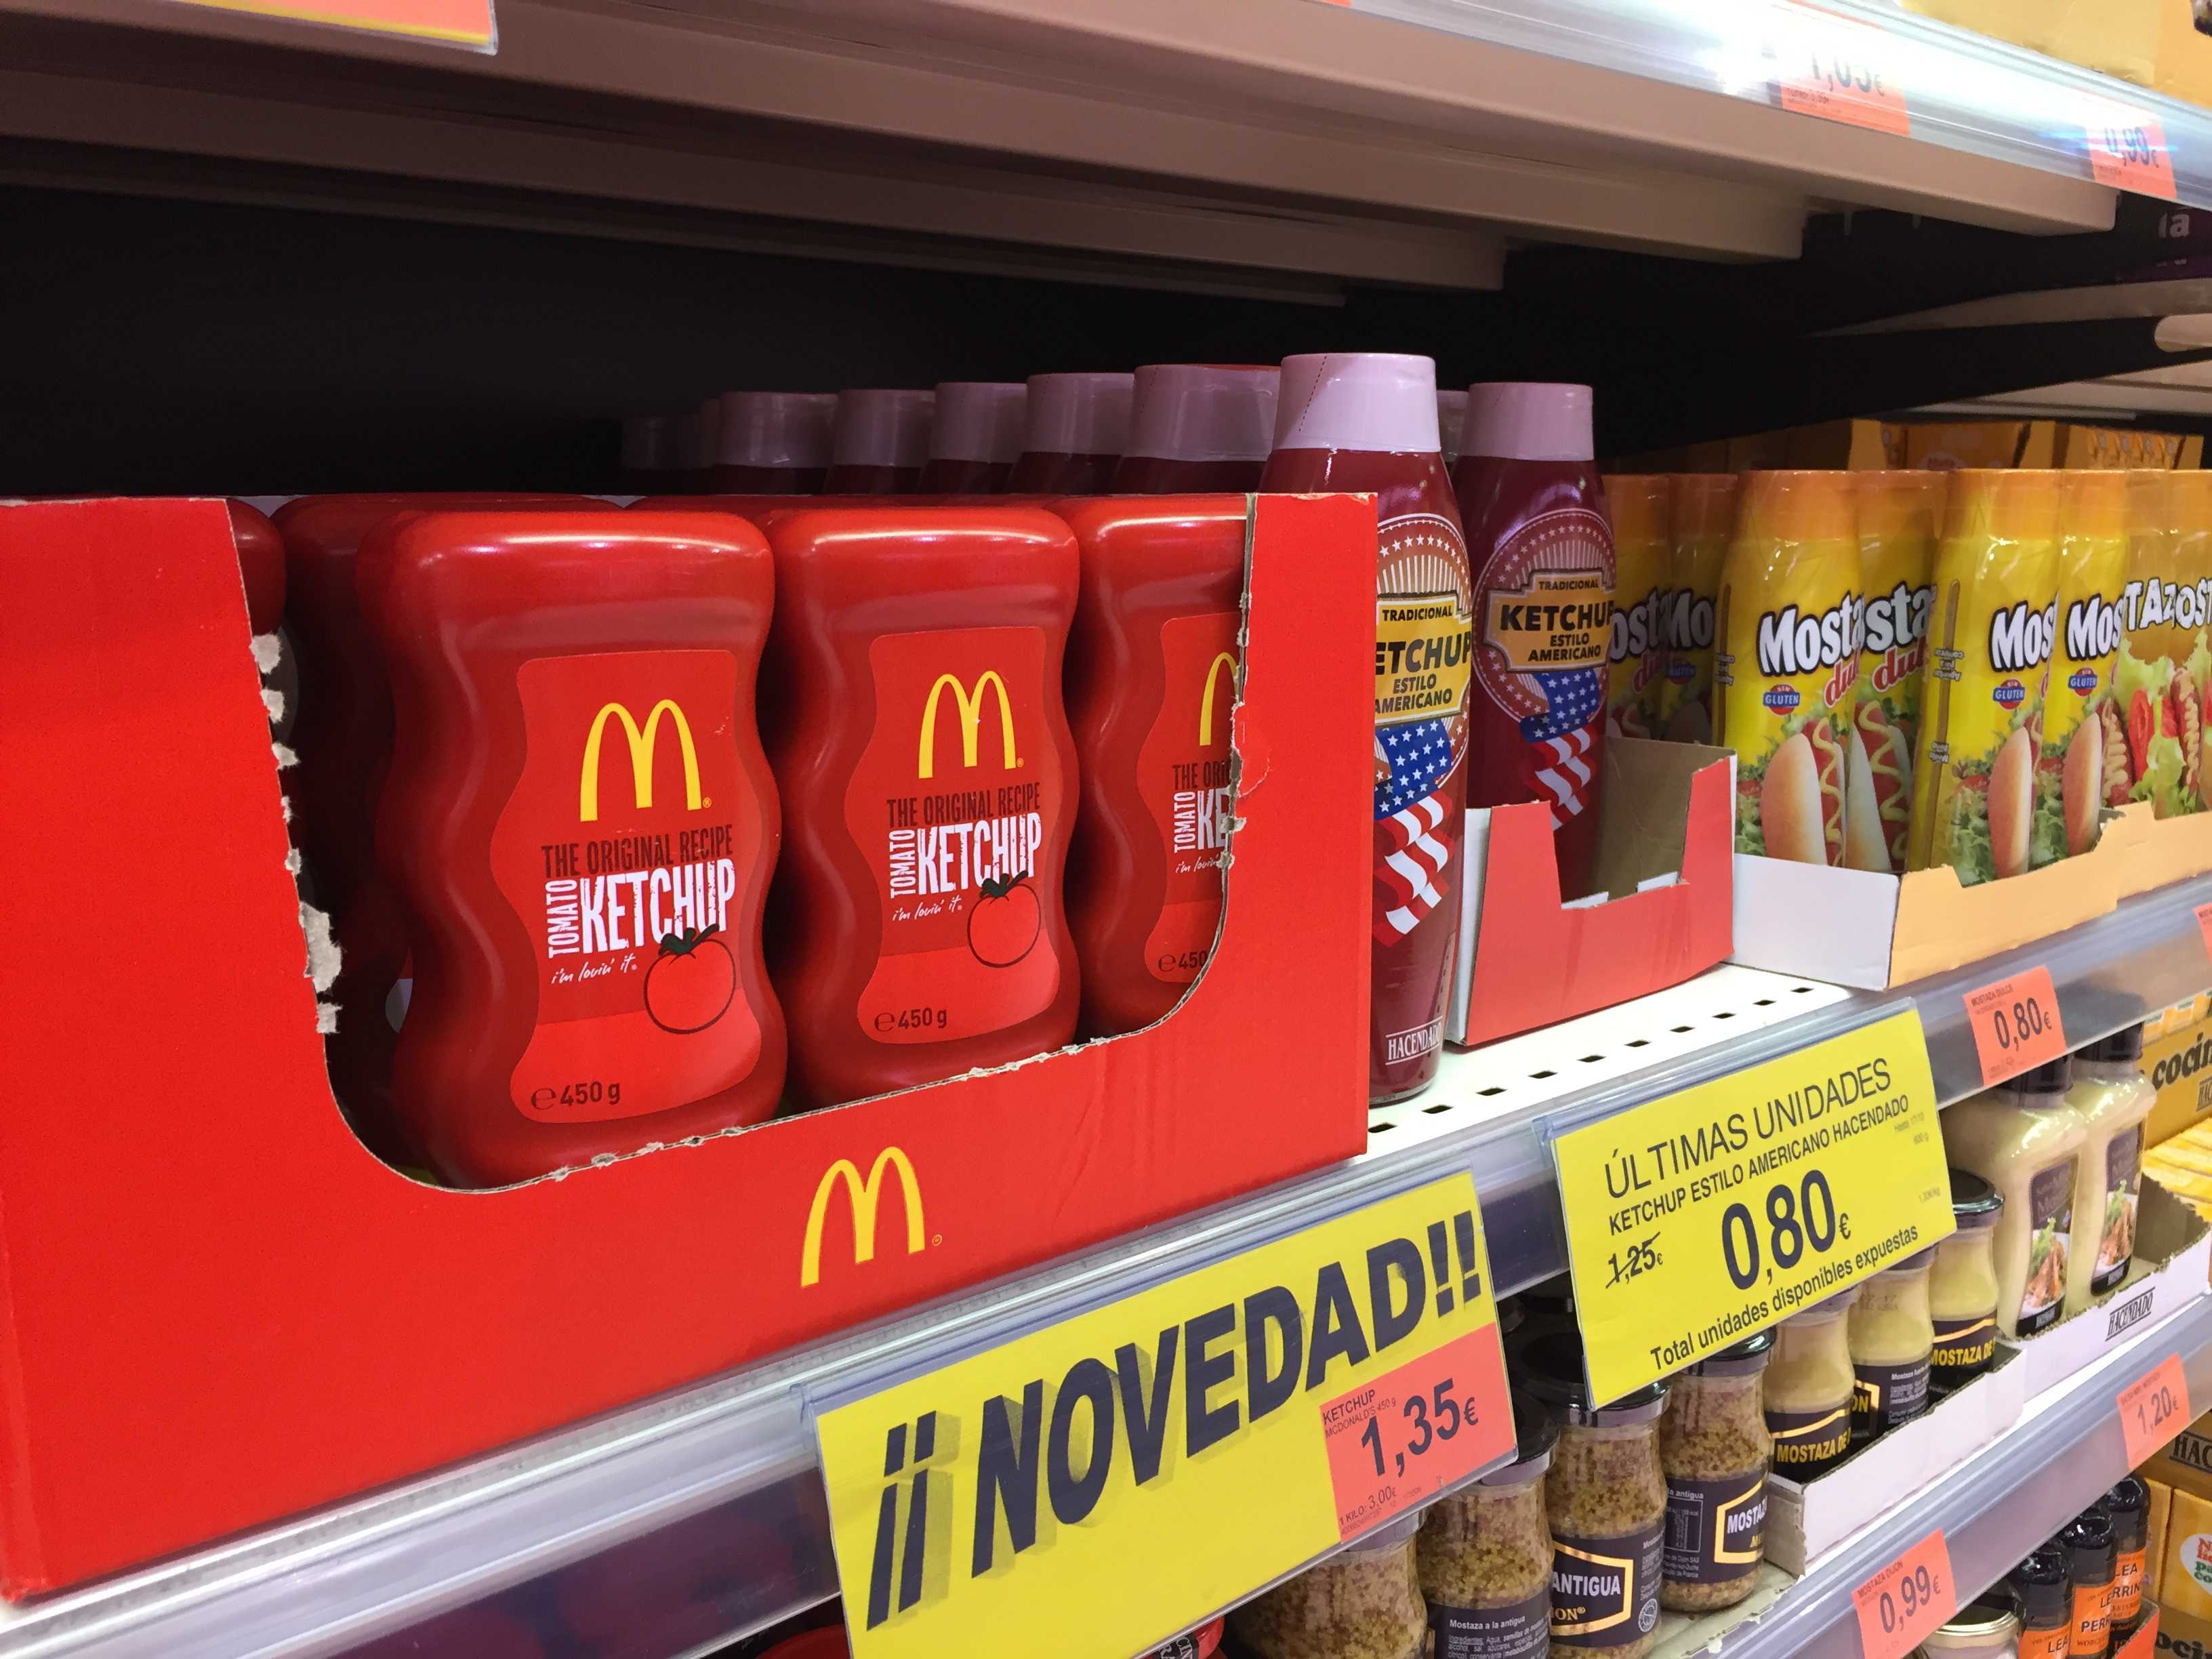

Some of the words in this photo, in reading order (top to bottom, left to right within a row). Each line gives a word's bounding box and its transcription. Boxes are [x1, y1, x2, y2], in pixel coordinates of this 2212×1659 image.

[1538, 579, 1599, 592] TRADICIONAL
[1382, 605, 1452, 621] TRADICIONAL
[1376, 630, 1471, 676] ETCHUP
[1528, 644, 1601, 663] AMERICANO
[1550, 632, 1589, 648] ESTILO
[1393, 673, 1437, 695] ESTILO
[1765, 694, 1799, 705] GLUTEN
[1995, 689, 2024, 701] GLUTEN
[2070, 678, 2097, 688] GLUTEN
[1172, 762, 1197, 790] THE
[886, 799, 918, 828] THE
[923, 789, 993, 825] ORIGINAL
[998, 781, 1040, 815] RECIPE
[1174, 791, 1196, 854] TOMATO
[541, 843, 579, 878] THE
[587, 834, 674, 876] ORIGINAL
[679, 823, 734, 862] RECIPE
[888, 829, 916, 899] TOMATO
[918, 812, 1042, 896] KETCHUP
[545, 879, 579, 959] TOMATO
[579, 858, 736, 955] KETCHUP
[1971, 991, 1996, 1007] MOSTAZA
[1387, 1021, 1442, 1061] HACENDADO
[1994, 997, 2052, 1052] 0,80€
[1605, 1113, 1749, 1198] ÚLTIMAS
[1755, 1057, 1891, 1139] UNIDADES
[1609, 1186, 1687, 1236] KETCHUP
[1691, 1164, 1744, 1204] ESTILO
[1748, 1128, 1830, 1179] AMERICANO
[1832, 1094, 1909, 1142] HACENDADO
[1721, 1168, 1852, 1290] 0,80€
[1651, 1332, 1695, 1371] Total
[1698, 1300, 1769, 1349] unidades
[1772, 1259, 1853, 1315] disponibles
[1856, 1224, 1919, 1272] expuestas
[2106, 1292, 2154, 1337] HACENDADO
[1322, 1389, 1376, 1426] KETCHUP
[1325, 1406, 1376, 1438] MCDONALD'S
[1361, 1377, 1479, 1479] 1,35€
[1777, 1441, 1837, 1464] MOSTAZA
[1676, 1490, 1704, 1500] antigua
[1551, 1571, 1621, 1597] ANTIGUA
[1858, 1574, 1887, 1599] MOSTAZA
[1879, 1565, 1941, 1633] 0,99€
[1449, 1618, 1483, 1630] Mostaza
[1492, 1620, 1500, 1629] la
[1500, 1615, 1525, 1628] antigua
